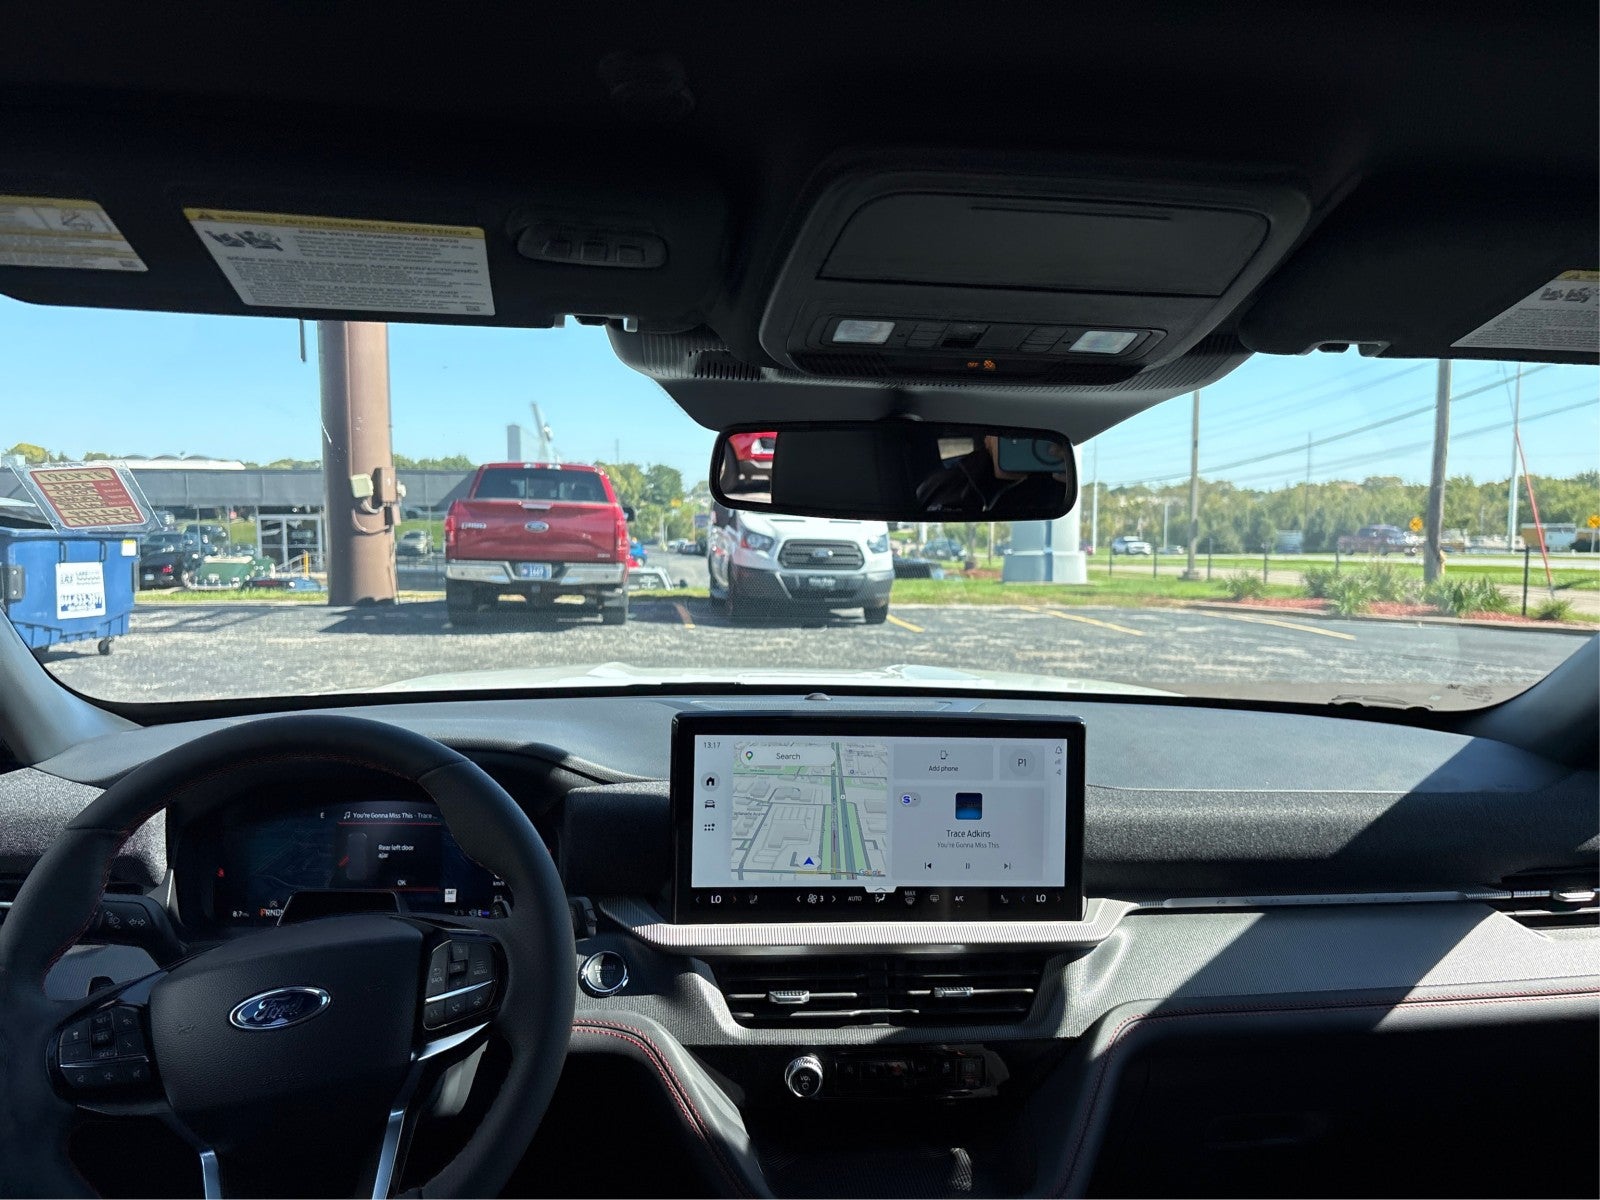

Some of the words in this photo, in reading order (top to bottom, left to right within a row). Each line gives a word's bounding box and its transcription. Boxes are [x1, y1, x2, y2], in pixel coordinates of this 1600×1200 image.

[776, 752, 801, 760] Search
[1017, 758, 1027, 767] P1
[941, 765, 959, 773] phone
[946, 829, 966, 838] Trace
[966, 829, 991, 838] Adkins
[859, 868, 882, 877] Google
[710, 895, 722, 904] LO
[1035, 894, 1047, 903] LO
